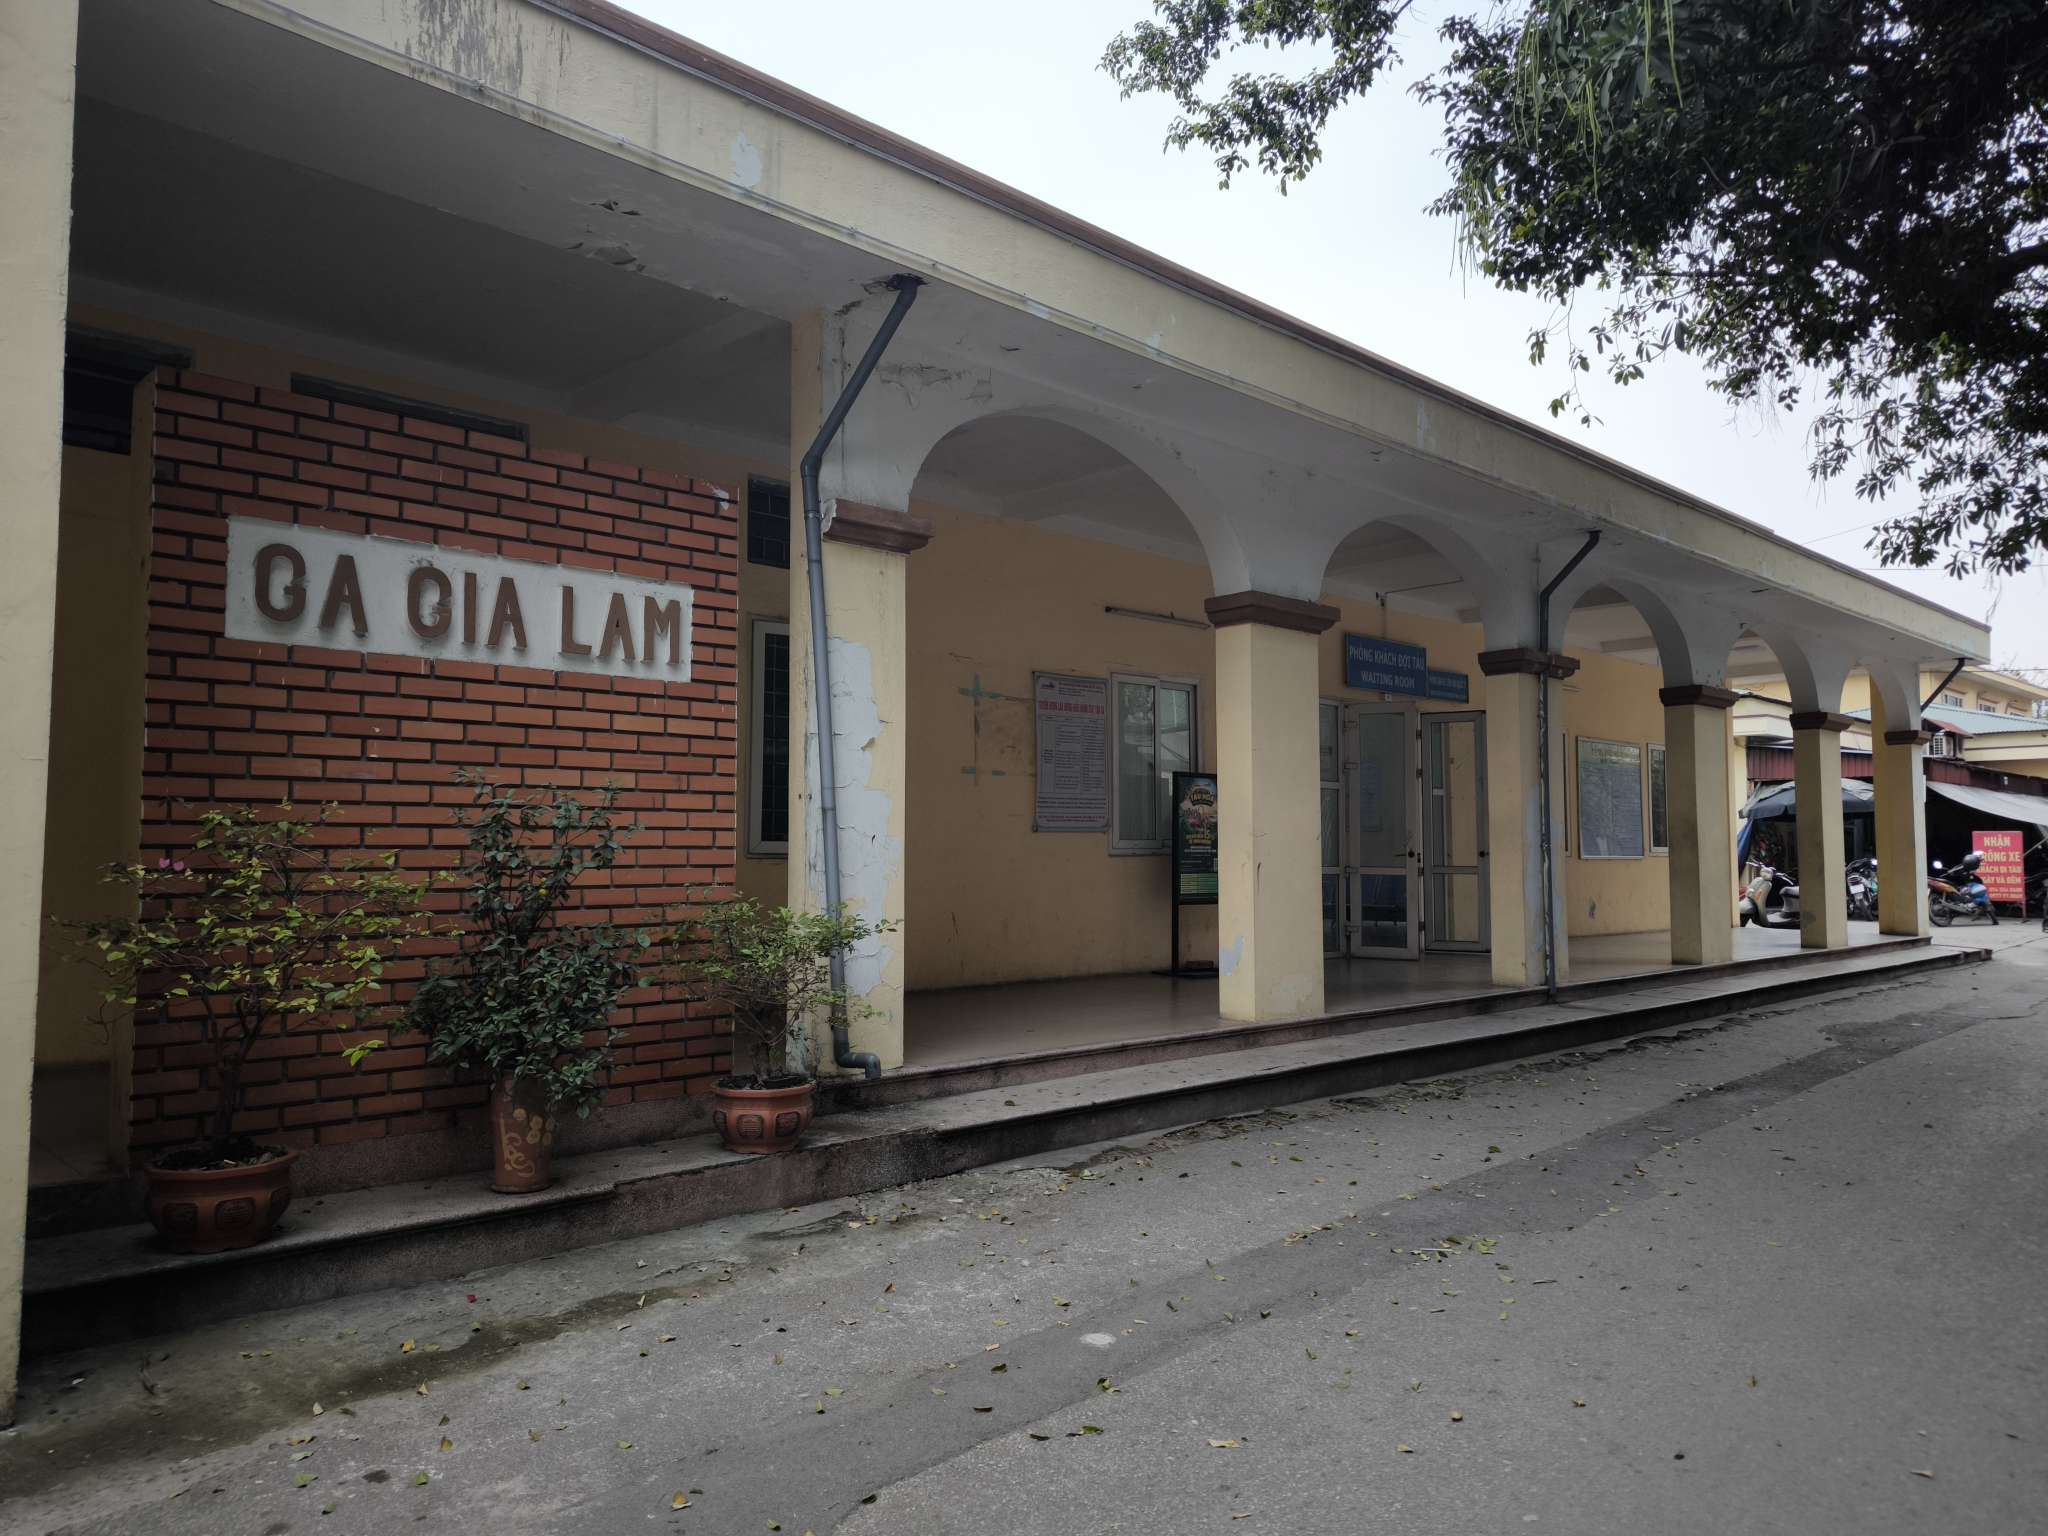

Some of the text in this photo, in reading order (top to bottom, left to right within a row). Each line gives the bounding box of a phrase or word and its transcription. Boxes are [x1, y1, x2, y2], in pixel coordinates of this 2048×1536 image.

[254, 543, 681, 664] GA GIA LAM
[1361, 671, 1393, 687] WAITING
[1394, 674, 1415, 689] ROOM
[2008, 851, 2021, 862] XE
